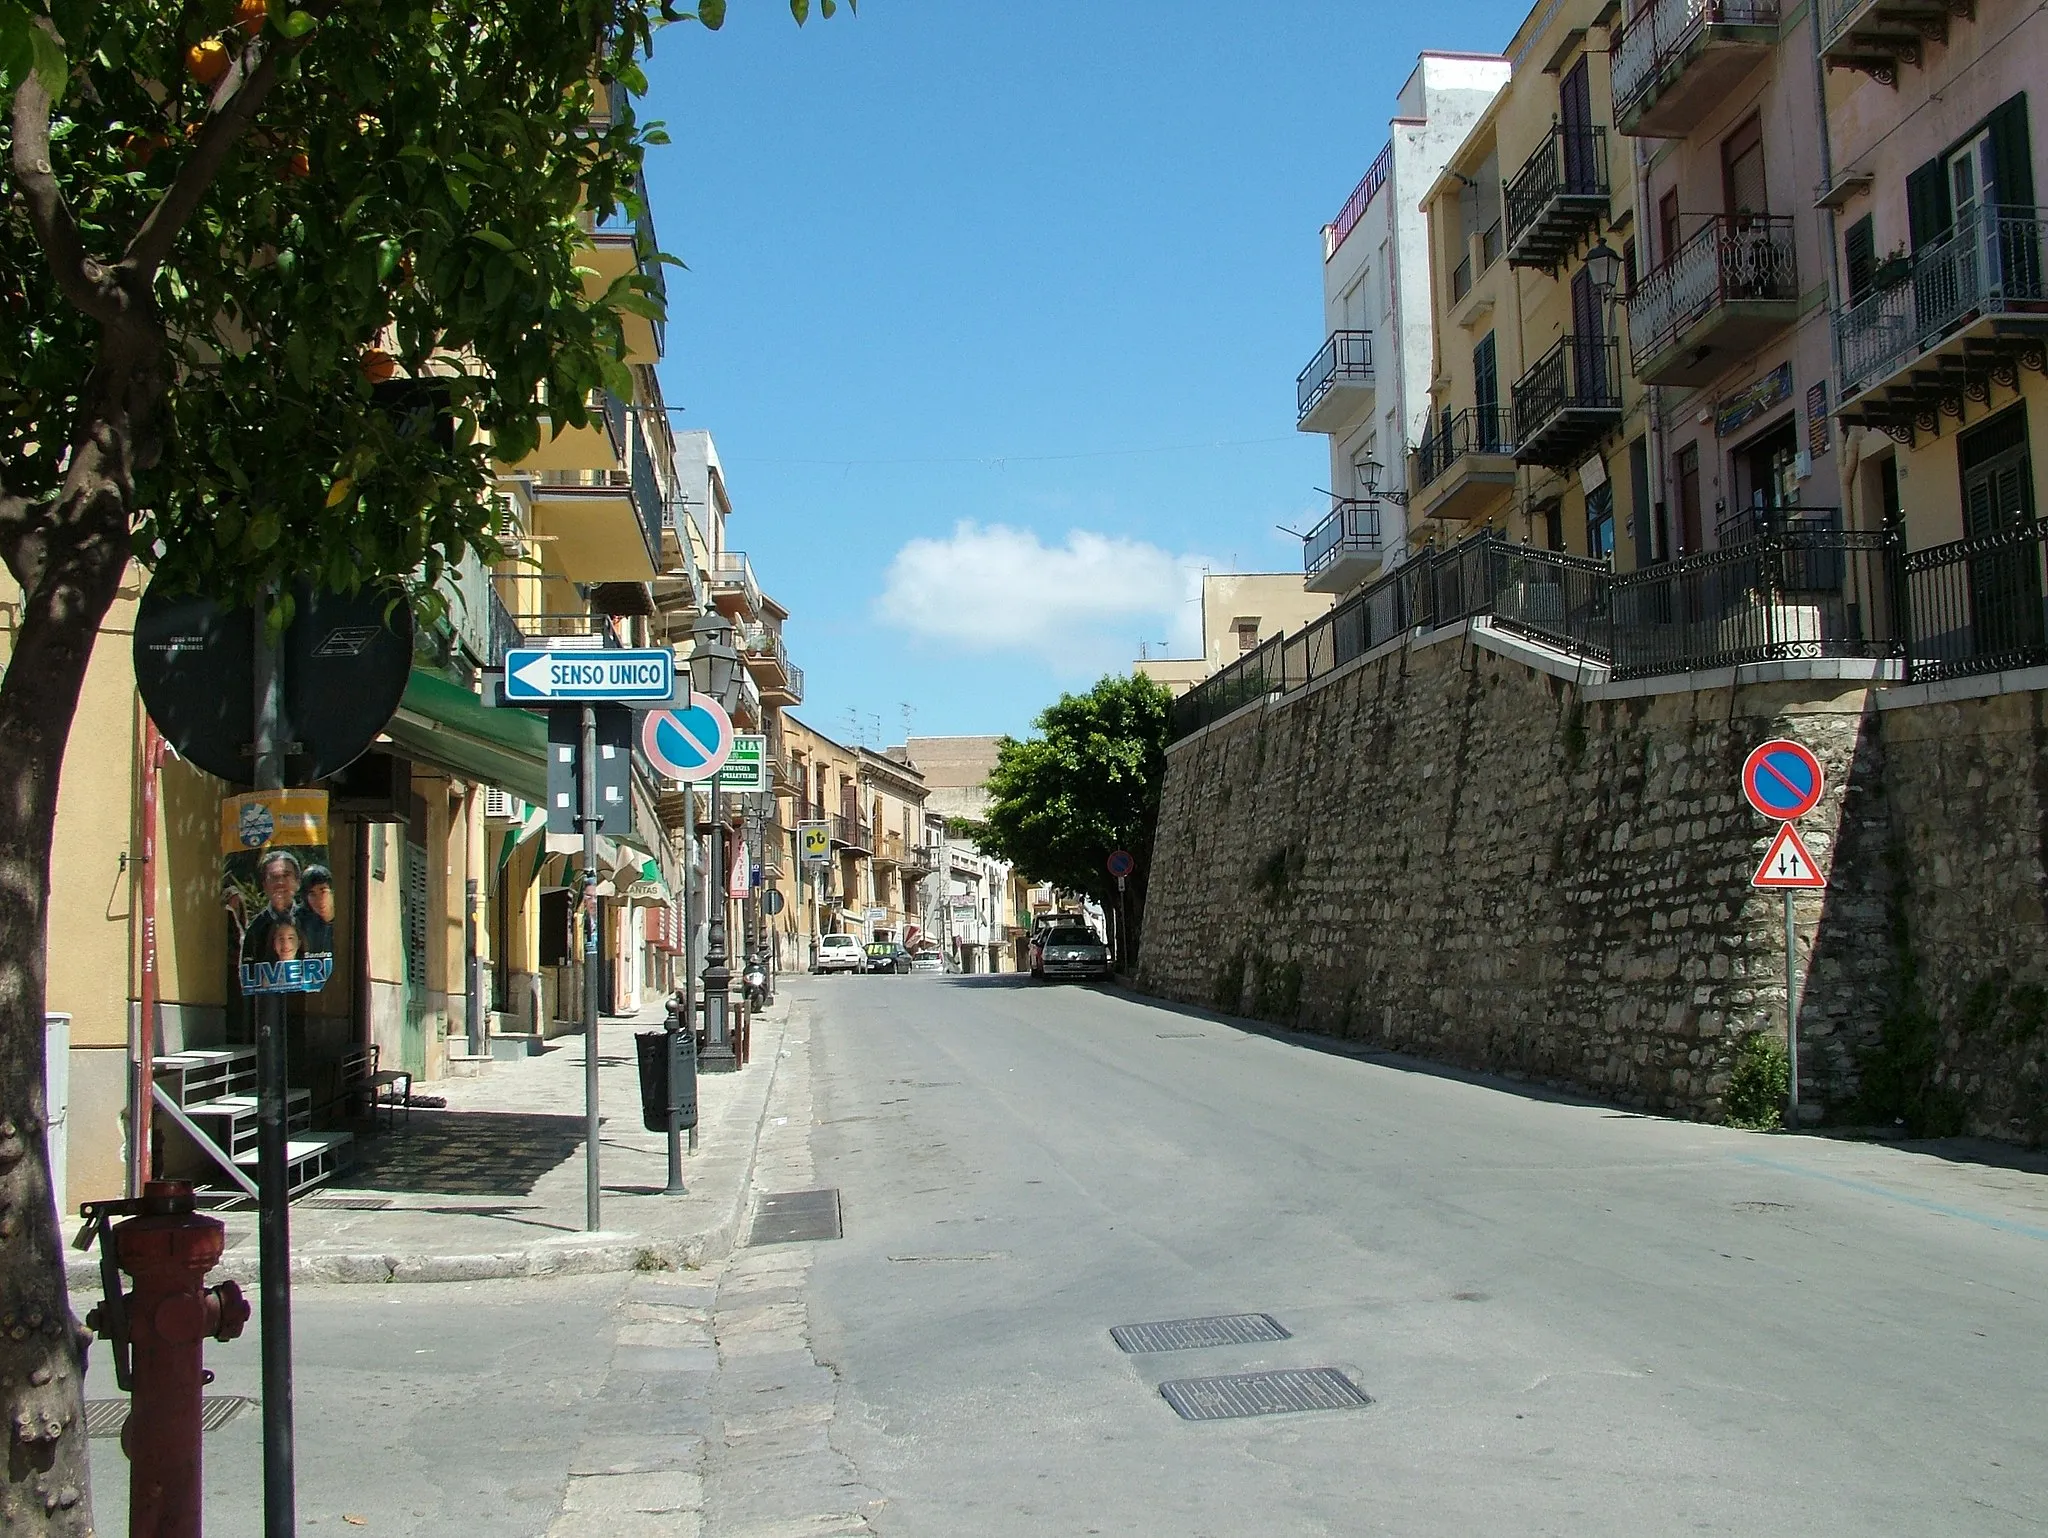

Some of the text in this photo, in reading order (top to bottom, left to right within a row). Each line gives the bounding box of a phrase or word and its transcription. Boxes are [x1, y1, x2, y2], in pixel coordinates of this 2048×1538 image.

[551, 664, 660, 685] SENSO UNICO
[732, 740, 760, 751] RIA
[806, 831, 826, 848] pt
[304, 951, 333, 959] Sandro
